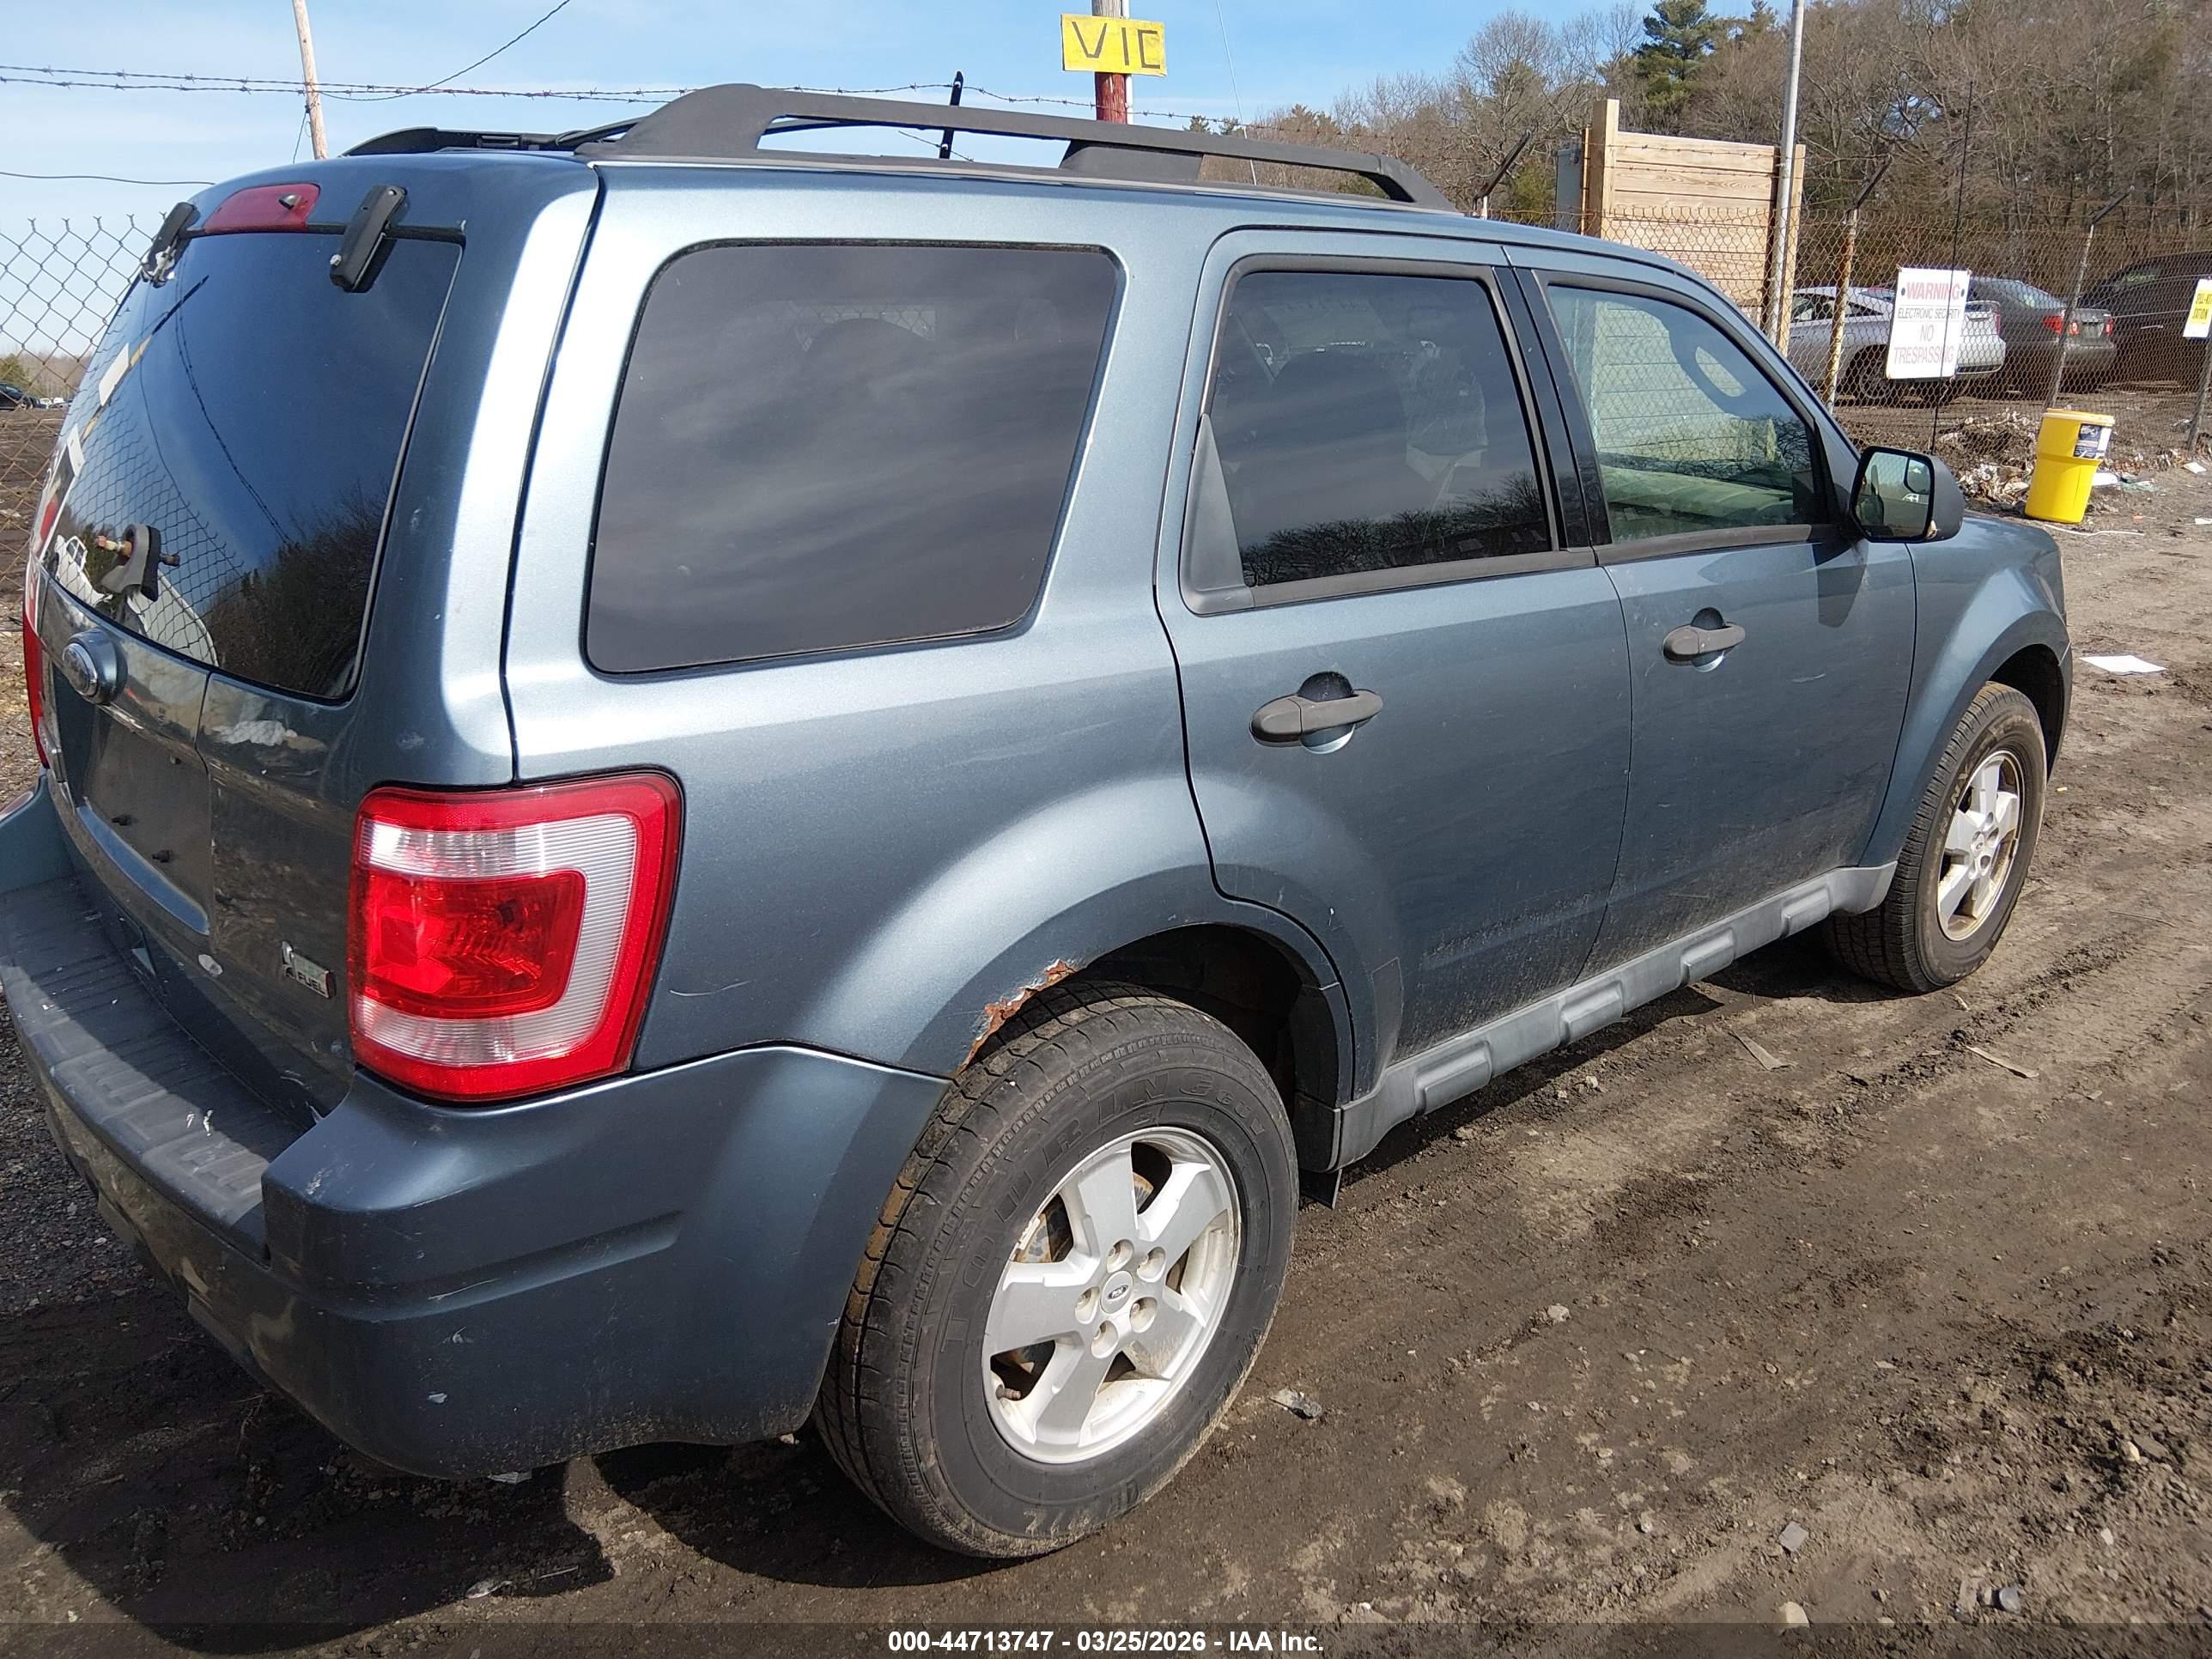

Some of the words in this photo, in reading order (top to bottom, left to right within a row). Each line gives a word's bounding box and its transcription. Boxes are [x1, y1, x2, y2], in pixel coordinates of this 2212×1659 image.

[1072, 21, 1161, 70] VIC
[1906, 282, 1960, 300] WARNING
[1897, 307, 1933, 319] ELECTRONIC
[1934, 307, 1961, 319] SECRITY
[1919, 324, 1934, 342] NO
[1893, 345, 1954, 364] TRESPASSING
[297, 971, 326, 994] FUEL
[940, 1071, 1213, 1354] TOURING
